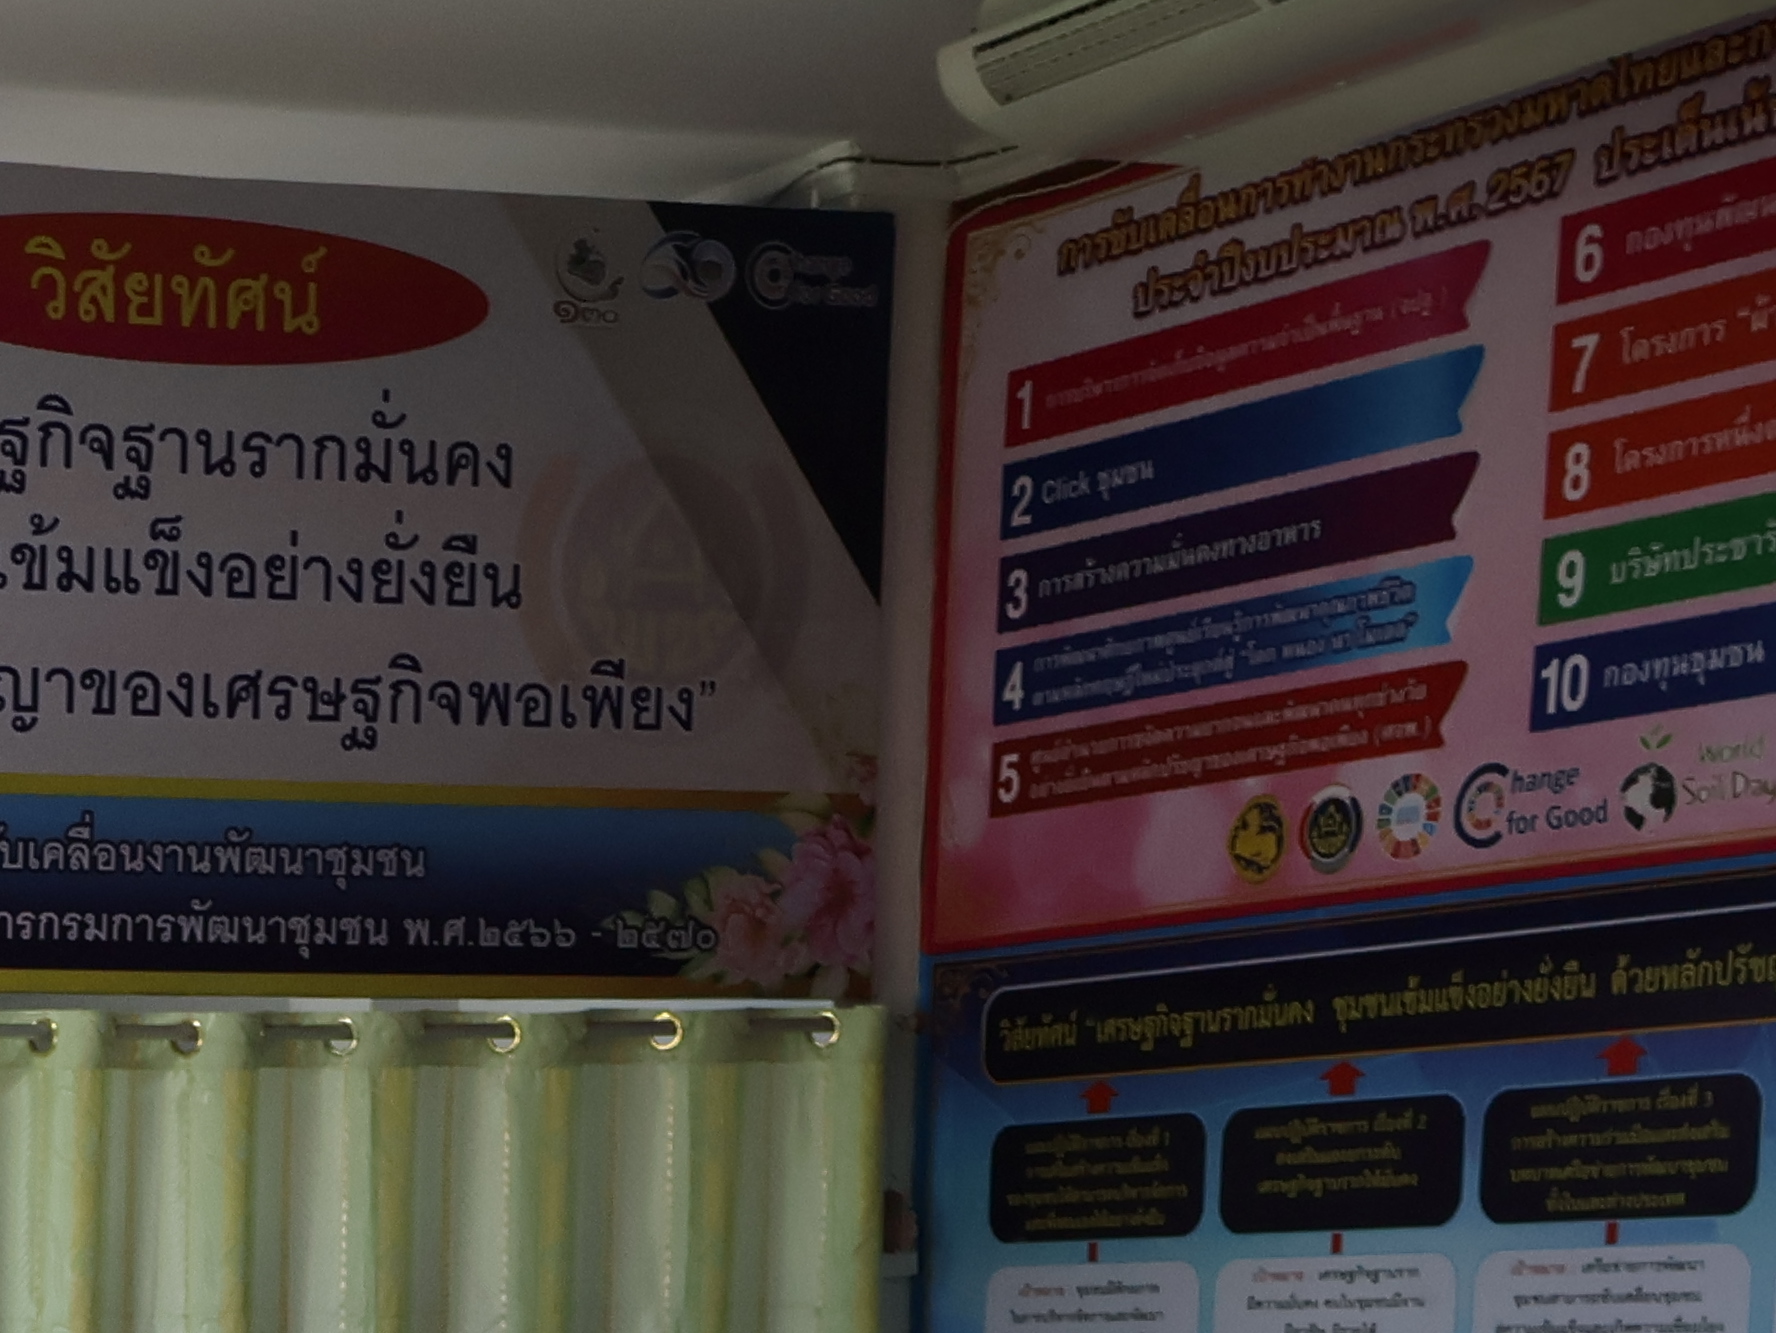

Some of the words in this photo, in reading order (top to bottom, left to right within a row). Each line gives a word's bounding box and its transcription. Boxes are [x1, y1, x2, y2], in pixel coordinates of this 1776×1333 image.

[1132, 207, 1405, 318] ประจำปีงบประมาณ
[1482, 151, 1576, 218] 2567
[1593, 89, 1776, 187] ประเด็นเน้
[1575, 224, 1605, 282] 6
[29, 232, 323, 336] วิสัยทัศน์
[1570, 333, 1601, 396] 7
[1619, 315, 1727, 366] โครงการ
[1014, 379, 1035, 431] 1
[1009, 475, 1034, 525] 2
[1041, 471, 1091, 506] Click
[1096, 460, 1155, 500] ชุมชน
[1563, 442, 1593, 502] 8
[1039, 516, 1323, 599] การสร้างความมั่นคงทางอาหาร
[1555, 550, 1587, 608] 9
[1608, 522, 1776, 587] บริษัทประชารั
[1005, 568, 1030, 620] 3
[1001, 662, 1025, 711] 4
[1539, 654, 1591, 717] 10
[1602, 638, 1766, 698] กองทุนชุมชน
[998, 751, 1021, 802] 5
[1506, 809, 1539, 835] for
[1545, 799, 1609, 830] Good
